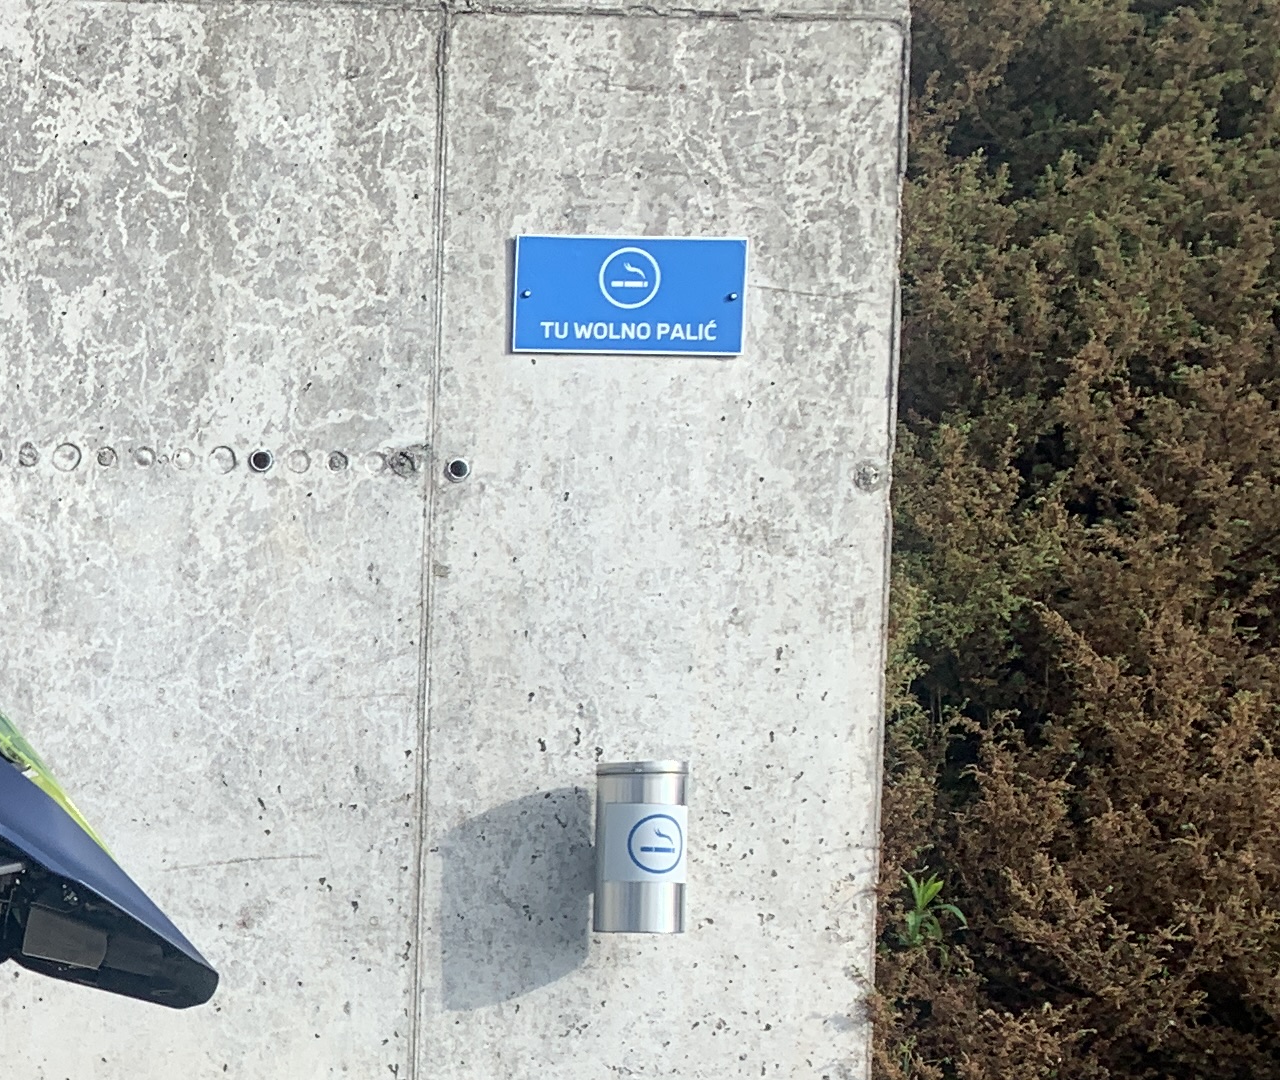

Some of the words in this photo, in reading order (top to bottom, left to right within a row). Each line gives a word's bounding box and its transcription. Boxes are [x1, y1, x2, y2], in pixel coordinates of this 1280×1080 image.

[540, 321, 568, 340] TU
[574, 322, 650, 340] WOLNO
[656, 319, 717, 341] PALIĆ
